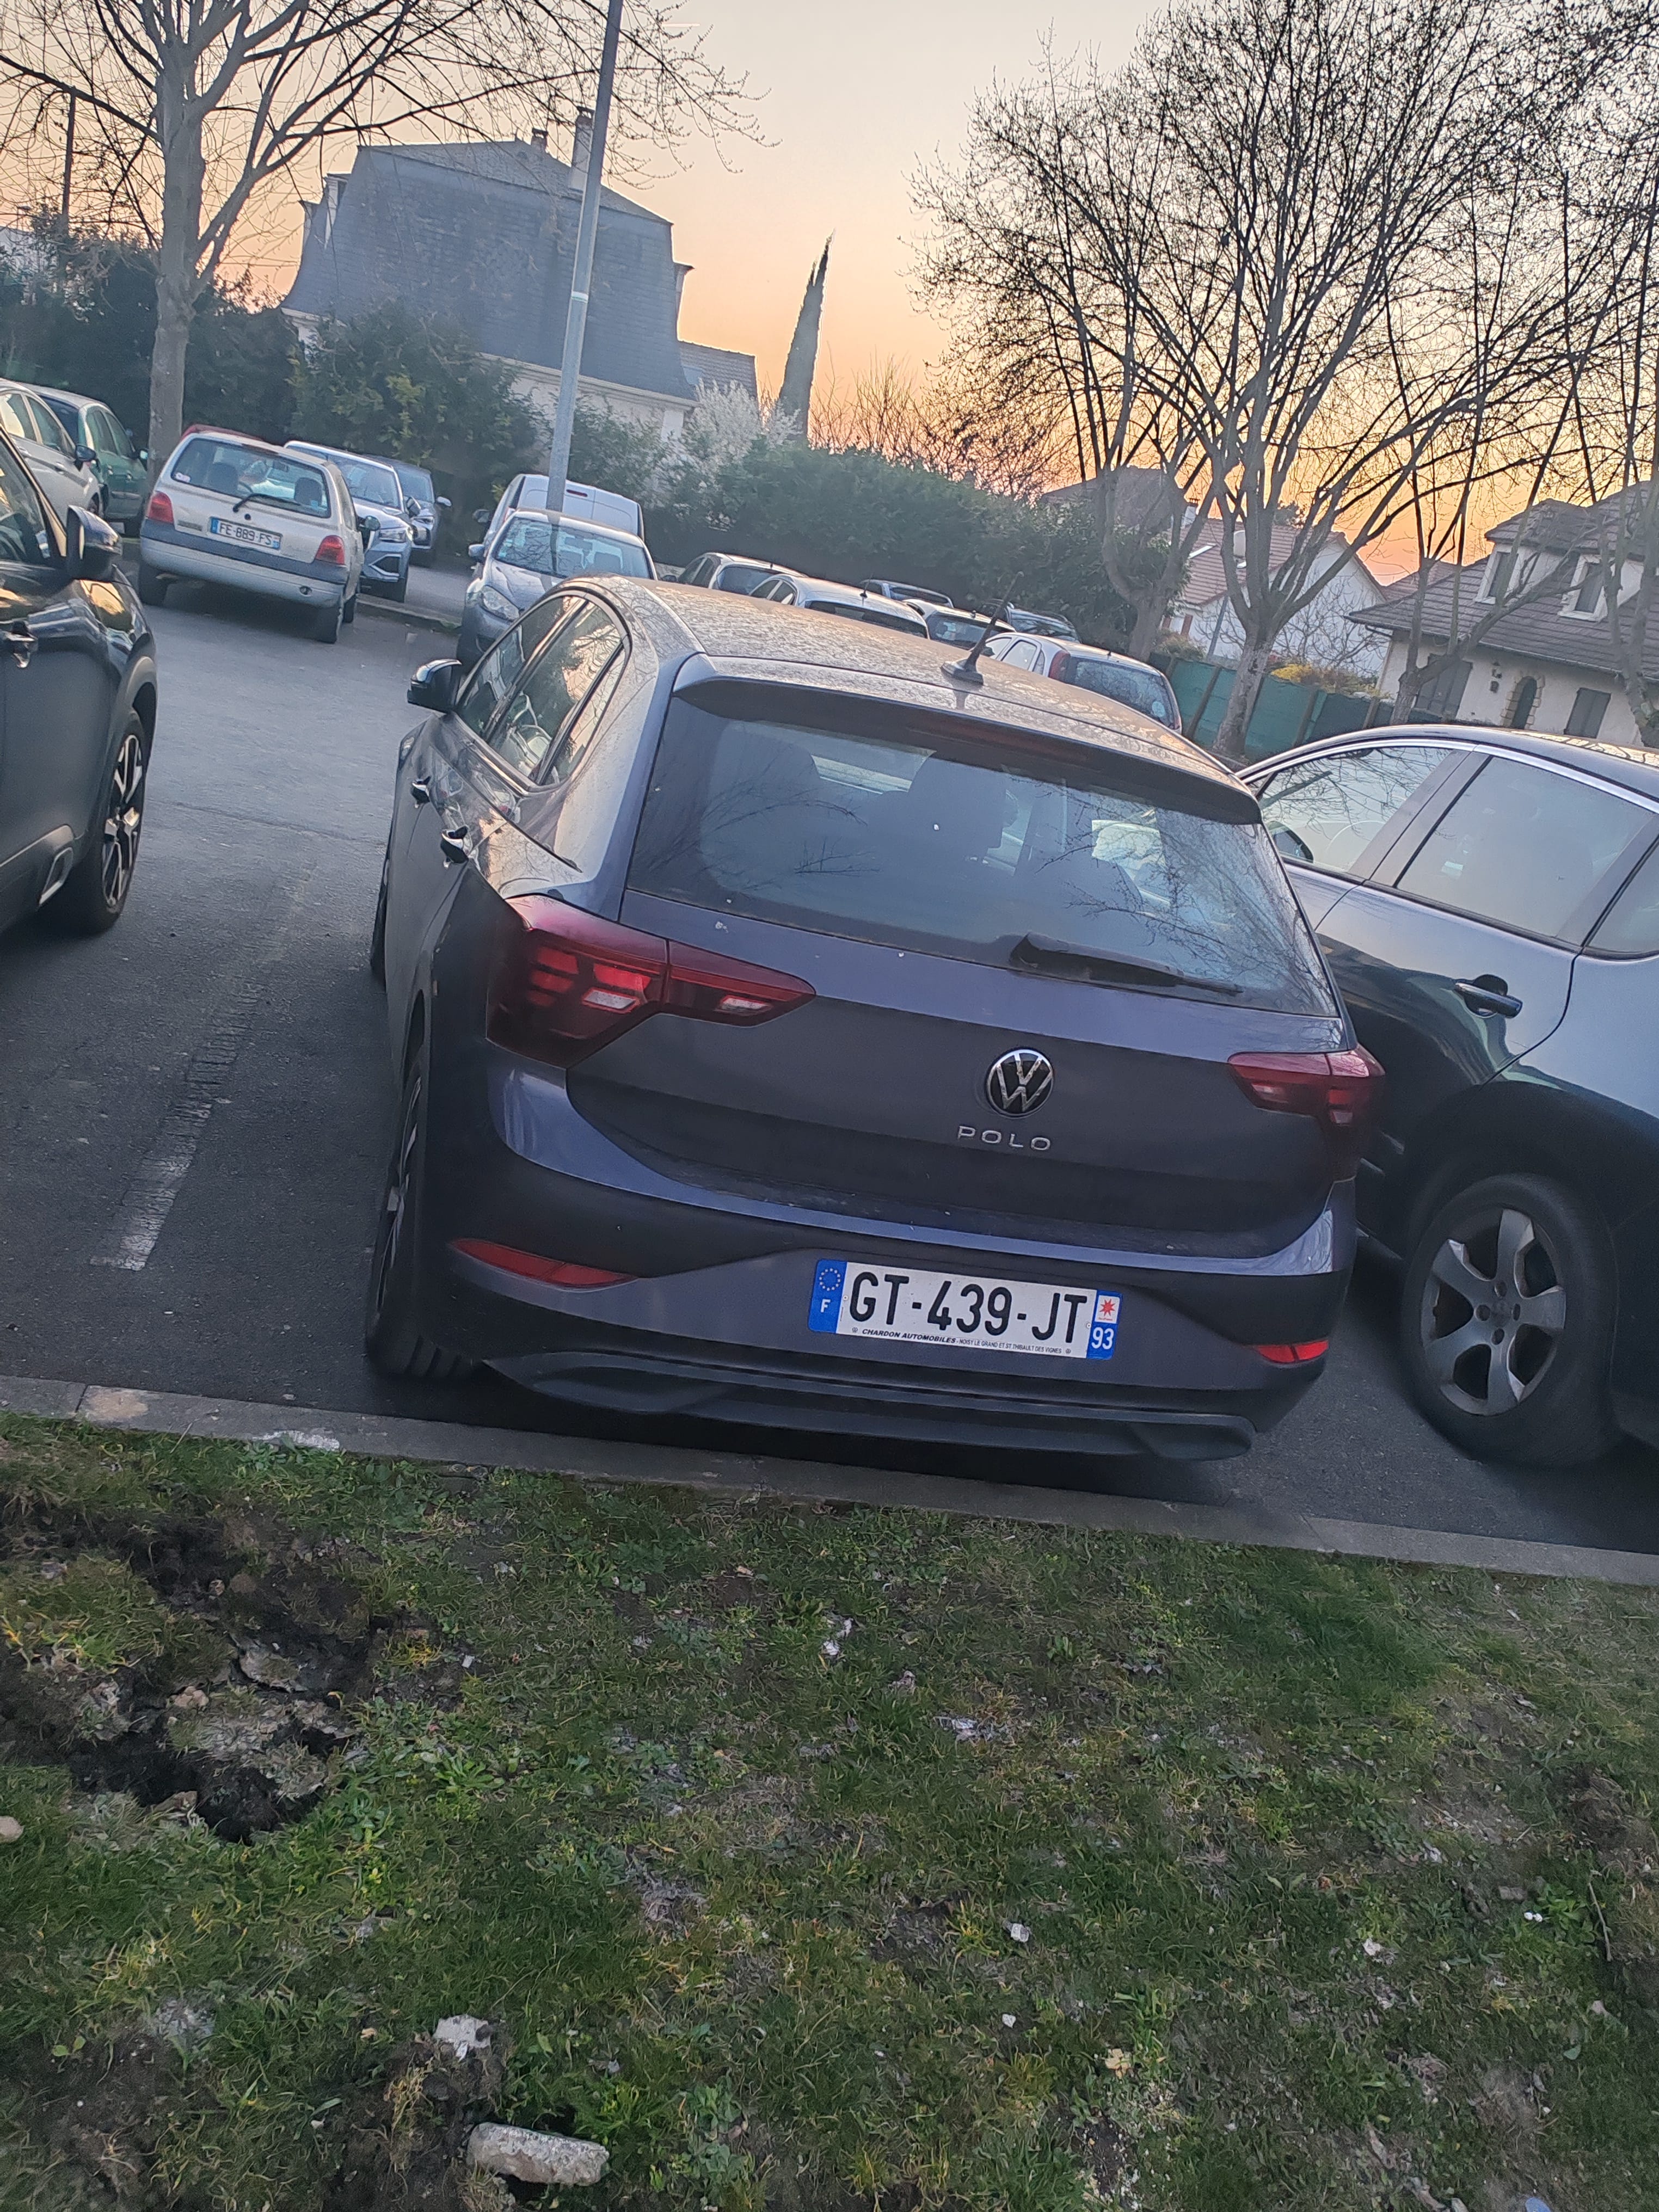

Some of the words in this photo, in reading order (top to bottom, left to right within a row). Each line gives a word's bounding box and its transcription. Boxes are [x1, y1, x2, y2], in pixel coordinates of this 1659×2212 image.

[958, 1126, 1050, 1151] POLO
[820, 1299, 831, 1312] F
[849, 1271, 1087, 1343] GT-439-JT
[862, 1329, 901, 1338] CHARDON
[902, 1333, 956, 1343] AUTOMOBILES
[1013, 1343, 1034, 1351] THIBAULT
[1091, 1327, 1114, 1350] 93
